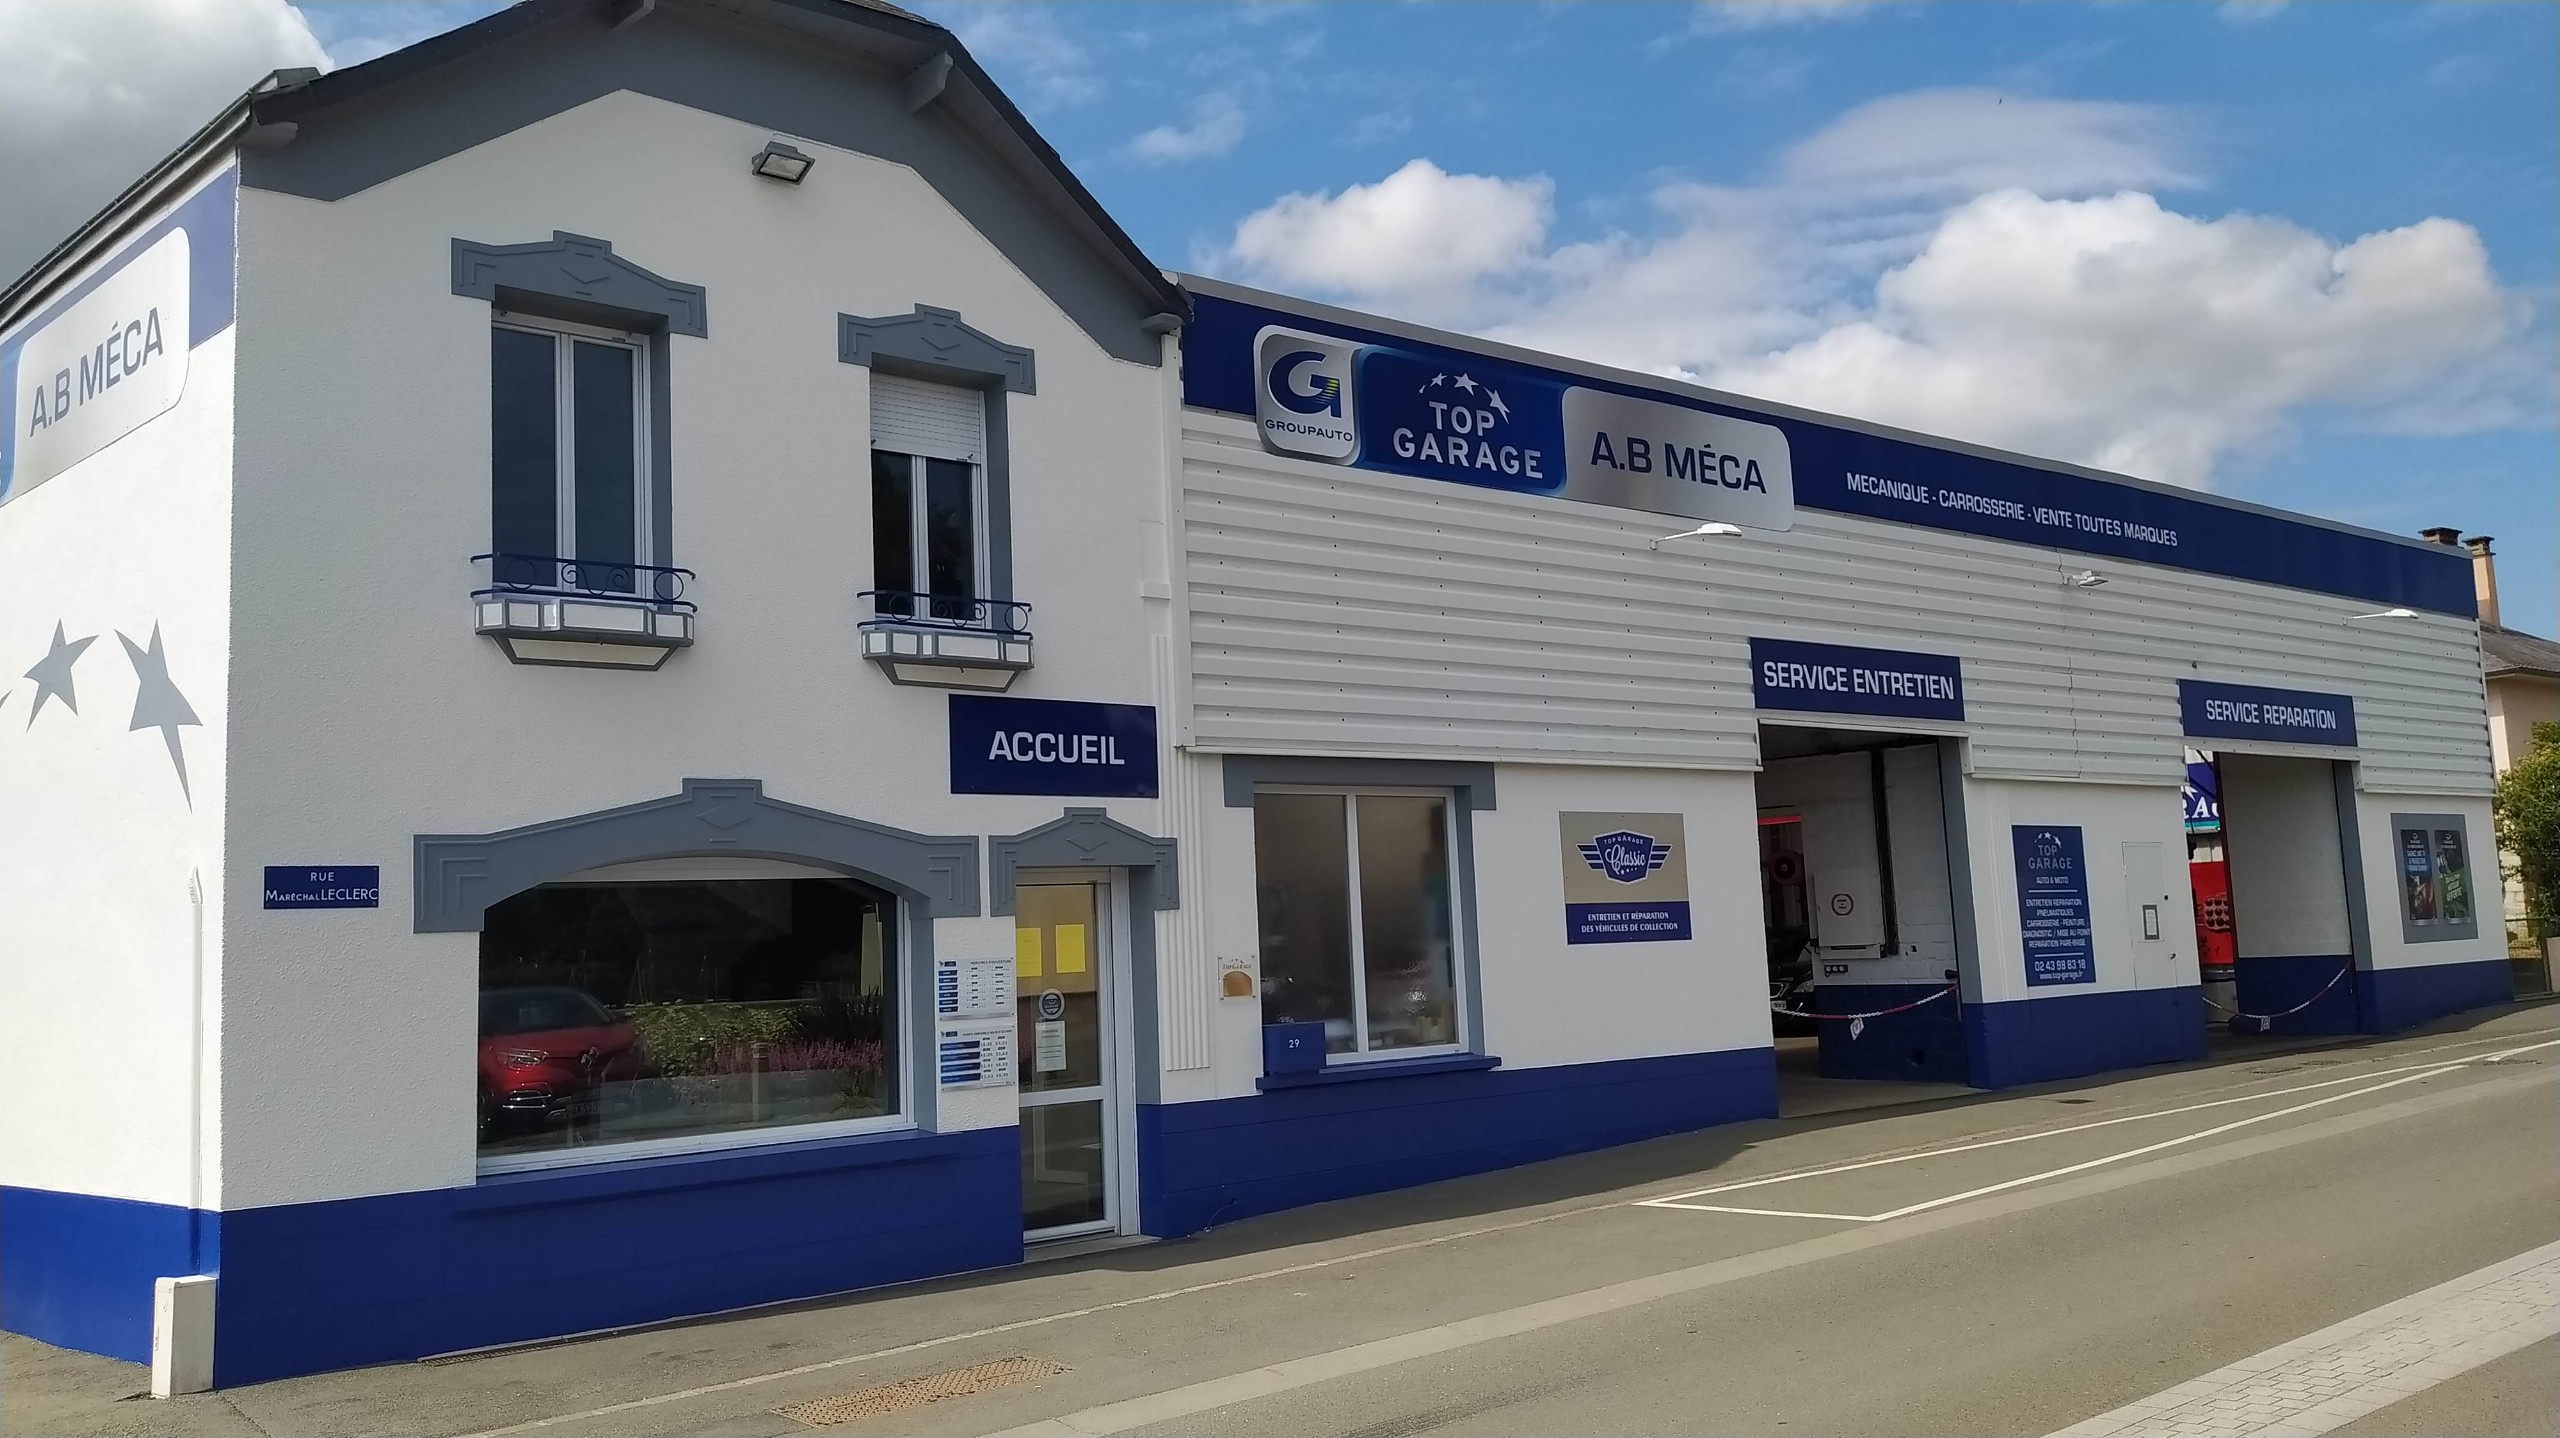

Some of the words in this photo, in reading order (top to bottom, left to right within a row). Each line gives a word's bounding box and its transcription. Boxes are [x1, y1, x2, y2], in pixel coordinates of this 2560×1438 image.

[30, 367, 71, 438] A.B
[79, 306, 164, 407] MÉCA
[1428, 400, 1496, 438] TOP
[1264, 417, 1354, 444] GROUPAUTO
[1392, 427, 1544, 480] GARAGE
[1590, 431, 1653, 474] A.B
[1664, 443, 1768, 495] MÉCA
[1846, 471, 1930, 505] MECANIQUE
[1939, 489, 2026, 522] CARROSSERIE
[2032, 506, 2073, 529] VENTE
[2075, 512, 2122, 538] TOUTES
[2123, 521, 2178, 547] MARQUES
[1763, 660, 1849, 692] SERVICE
[1852, 668, 1955, 700] ENTRETIEN
[2205, 699, 2260, 725] SERVICE
[2263, 704, 2338, 730] REPARATION
[988, 730, 1126, 766] ACCUEIL
[1617, 835, 1644, 845] GARAGE
[2037, 844, 2058, 856] TOP
[1605, 844, 1647, 875] Classic
[2028, 857, 2073, 870] GARAGE
[310, 871, 335, 882] RUE
[2036, 876, 2050, 884] AUTO
[2054, 876, 2069, 884] MOTO
[321, 888, 379, 901] LECLERC
[2026, 899, 2053, 907] ENTRETIEN
[1588, 913, 1621, 922] ENTRETIEN
[1622, 912, 1630, 921] ET
[1631, 910, 1669, 920] RÉPARATION
[2036, 908, 2075, 917] PNEUMATIQUES
[1581, 925, 1595, 933] DES
[1595, 922, 1629, 932] VÉHICULES
[1630, 923, 1639, 932] DE
[1640, 922, 1678, 931] COLLECTION
[2026, 919, 2060, 928] CARROSSERIE
[2063, 918, 2085, 926] PEINTURE
[2023, 930, 2053, 938] DIAGNOSTIC
[2057, 929, 2069, 937] MISE
[2070, 929, 2077, 937] AU
[2077, 928, 2091, 936] POINT
[2060, 938, 2087, 947] PARE-BRISE
[2034, 961, 2045, 971] 02
[2045, 960, 2056, 971] 43
[1289, 1038, 1300, 1049] 29
